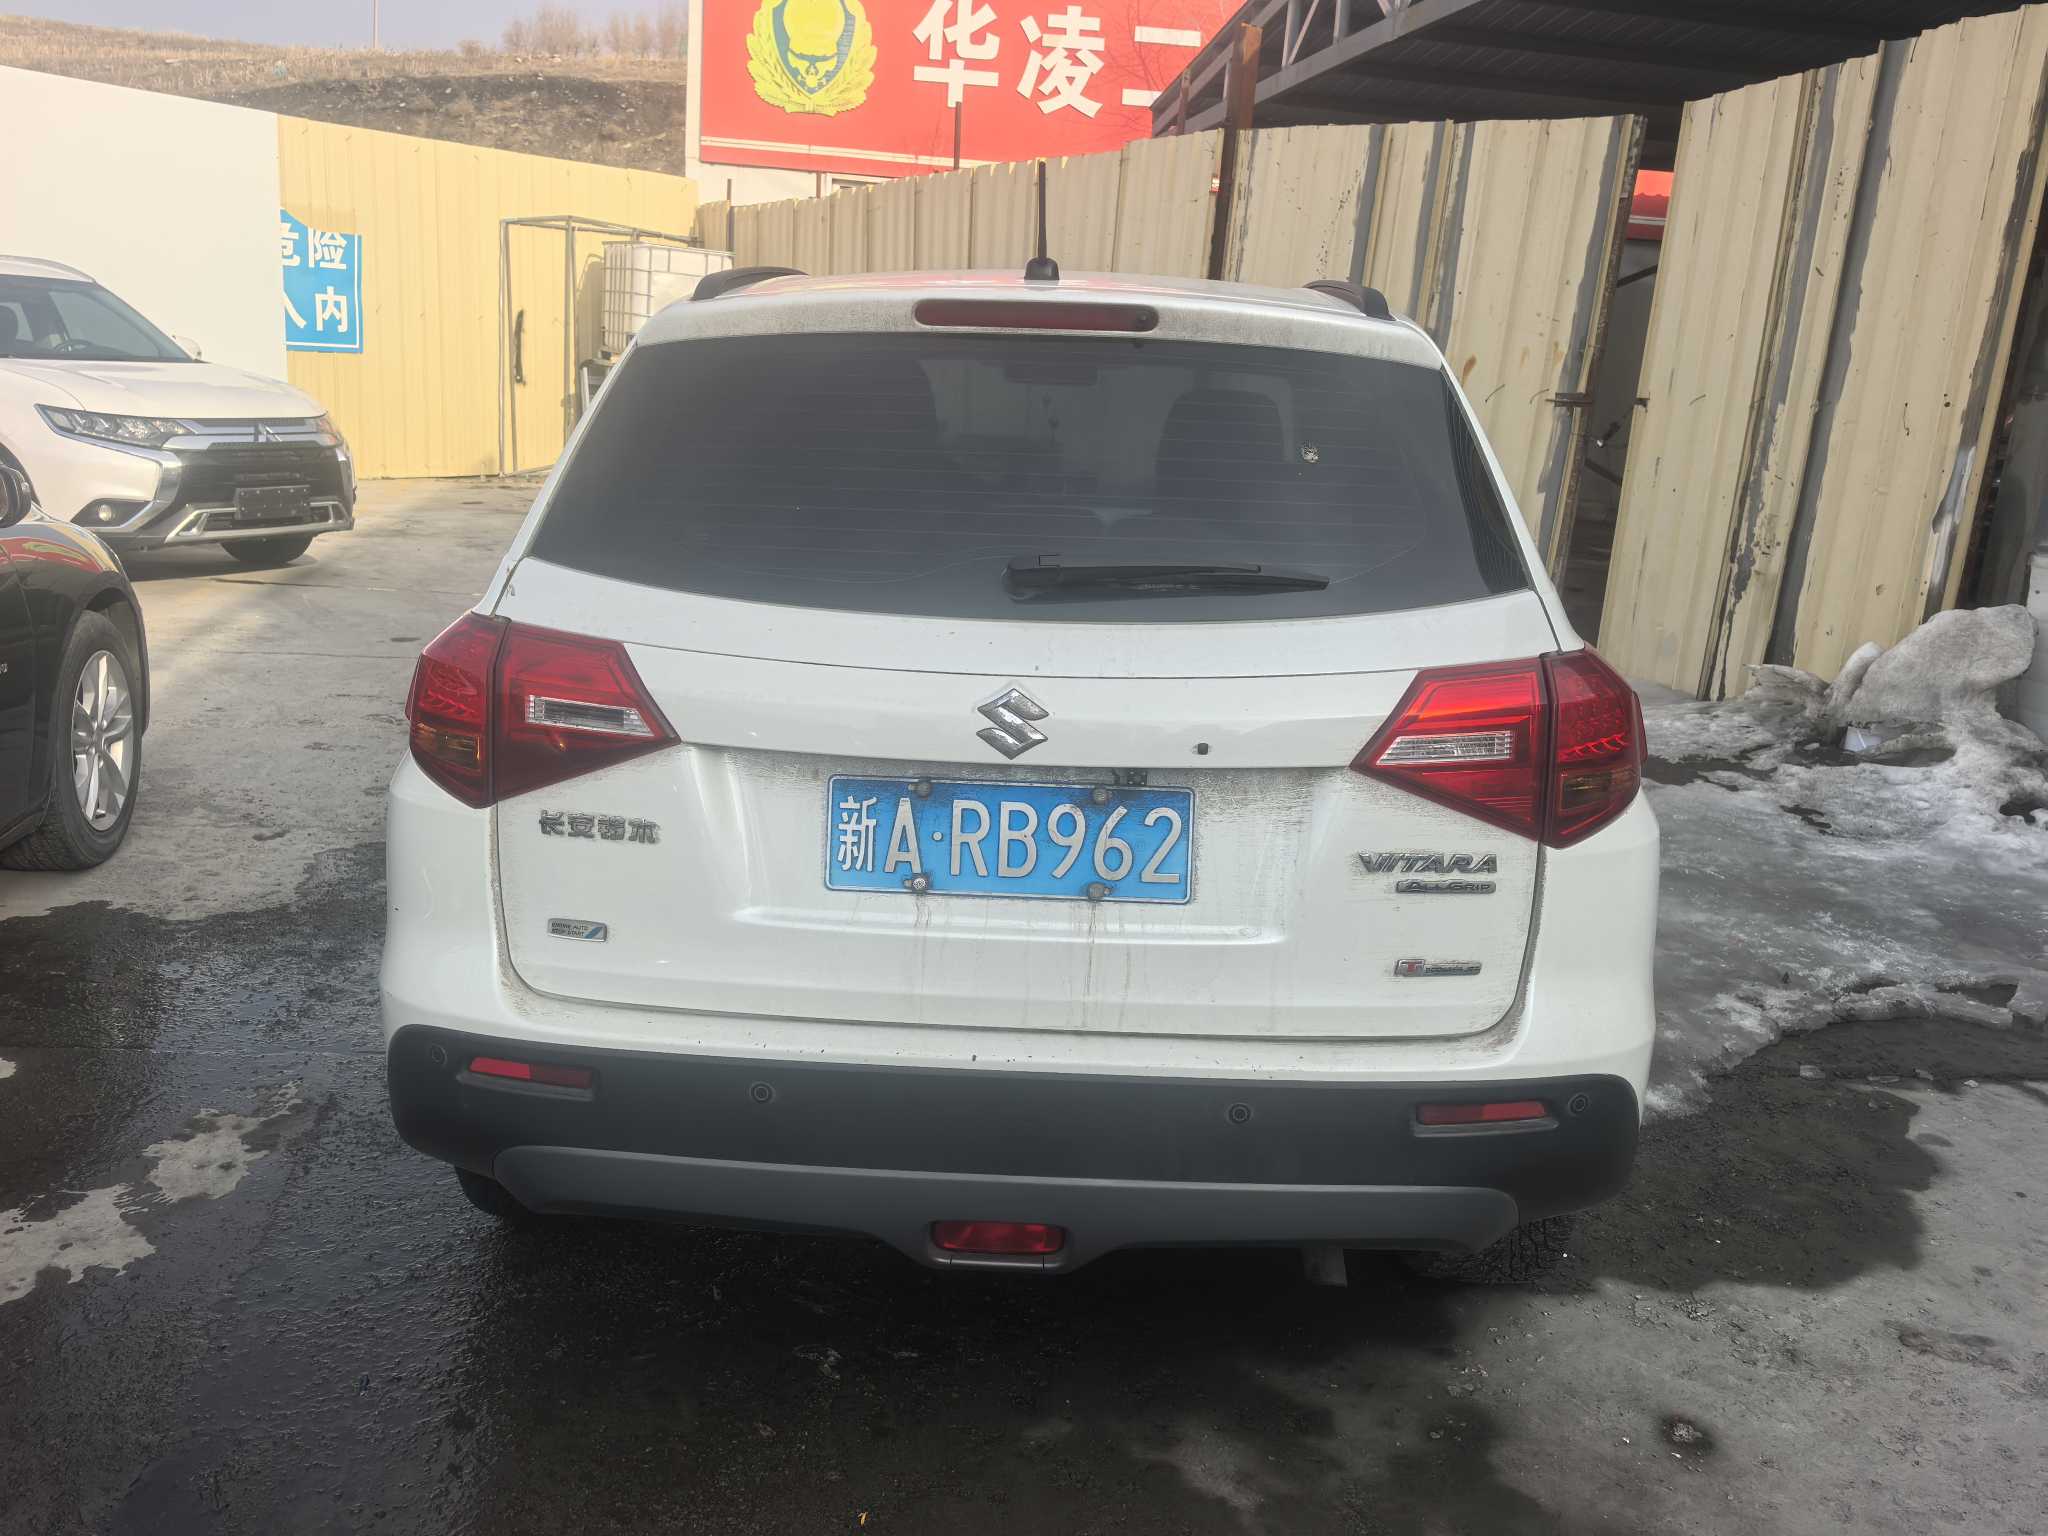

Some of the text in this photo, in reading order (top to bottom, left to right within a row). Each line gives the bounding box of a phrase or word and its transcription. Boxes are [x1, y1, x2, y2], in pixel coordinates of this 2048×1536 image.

[912, 0, 1201, 119] 华凌二
[837, 794, 1183, 884] 新A·RB962
[1359, 853, 1498, 874] VITARA
